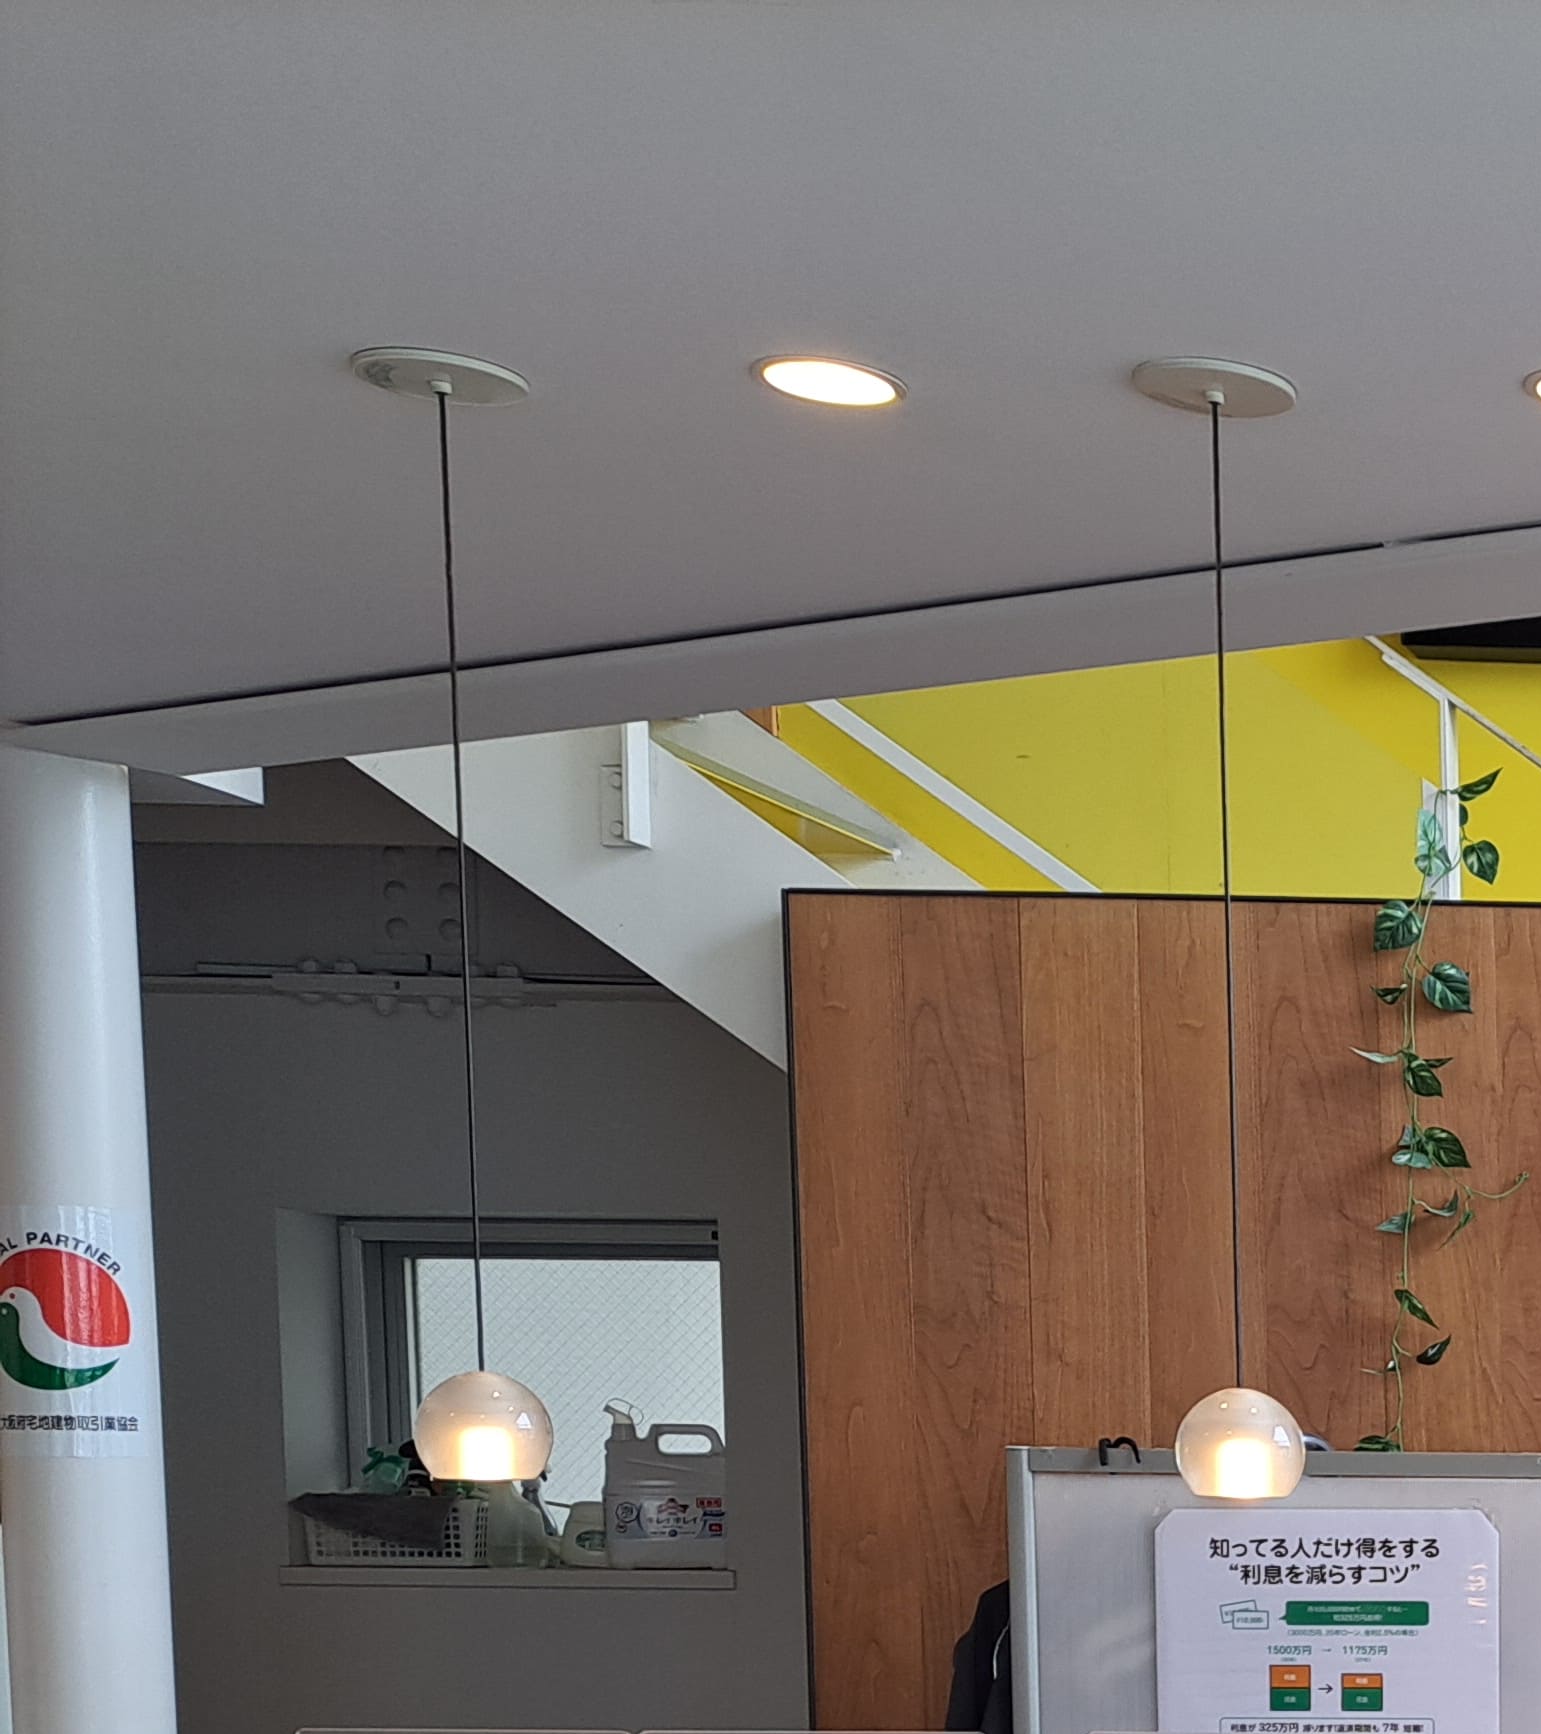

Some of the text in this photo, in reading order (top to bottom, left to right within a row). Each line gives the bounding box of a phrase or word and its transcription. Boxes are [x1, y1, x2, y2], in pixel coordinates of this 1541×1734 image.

[25, 1231, 122, 1276] PARTNER
[1209, 1537, 1440, 1559] 知ってる人だけ得をする
[1267, 1645, 1388, 1655] 1500万円 1175万円
[1258, 1722, 1299, 1733] 325万円
